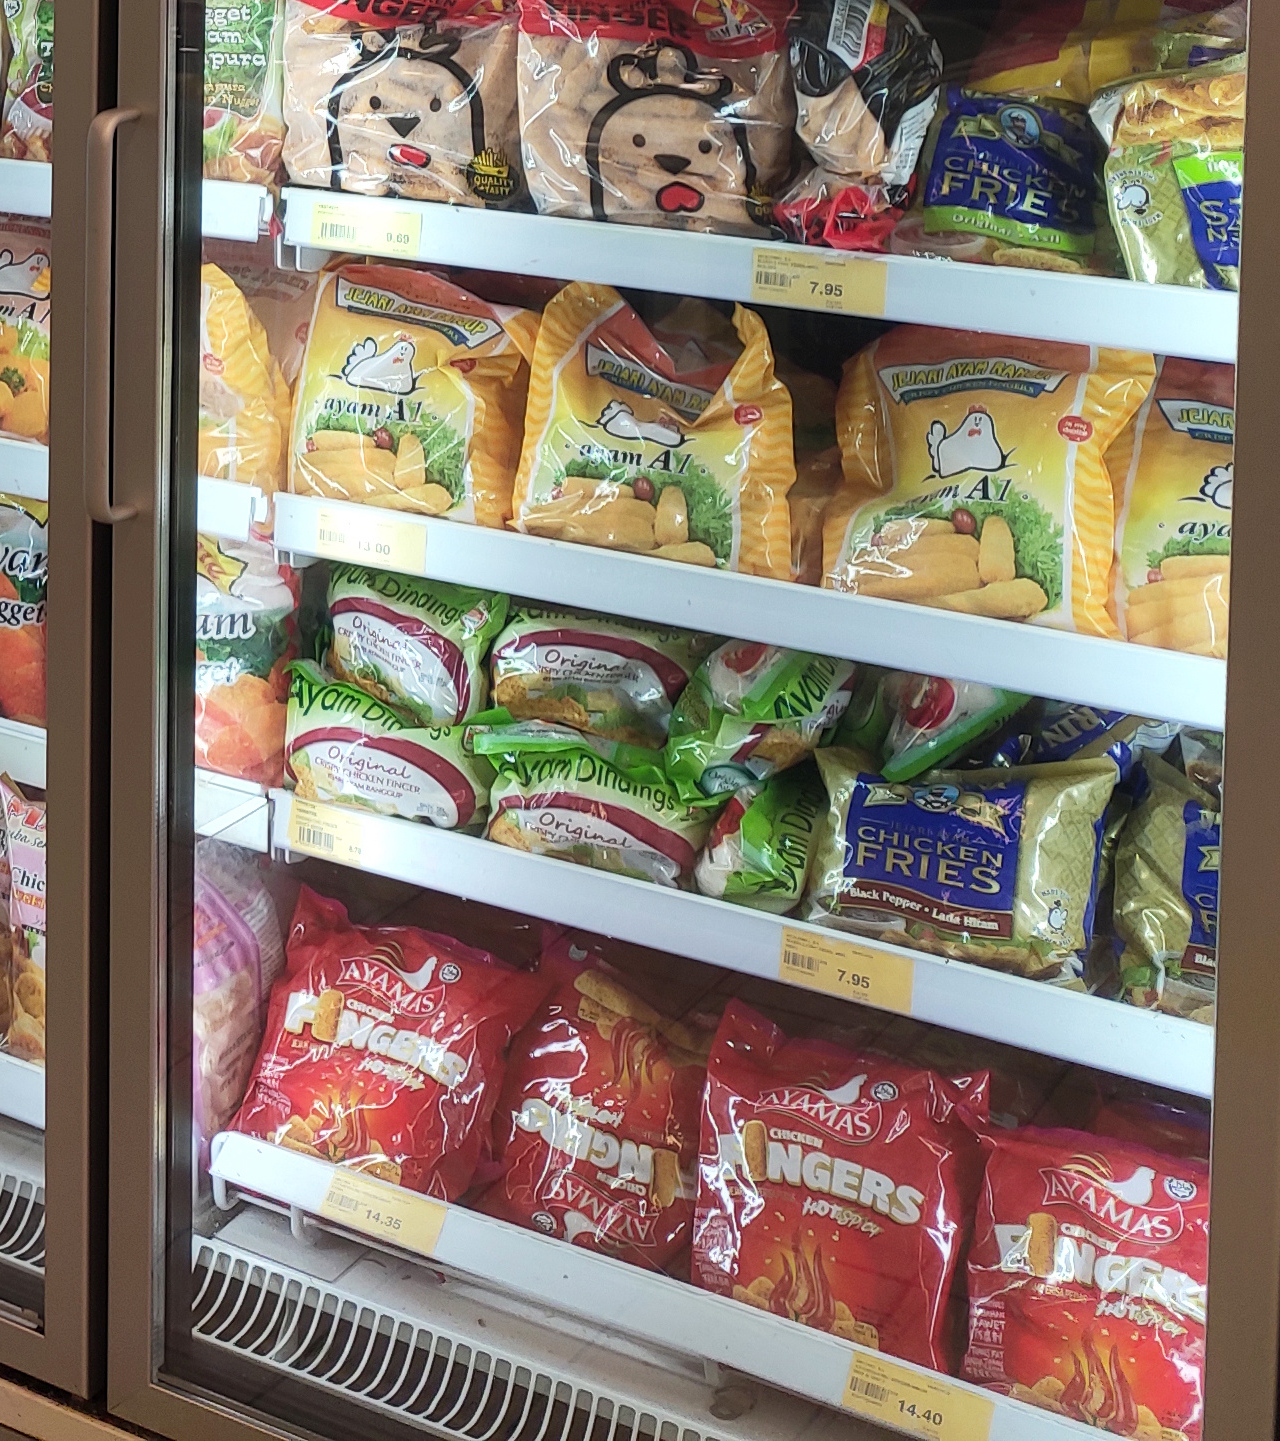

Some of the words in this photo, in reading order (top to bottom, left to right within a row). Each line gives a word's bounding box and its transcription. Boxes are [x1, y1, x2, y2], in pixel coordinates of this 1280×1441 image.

[473, 174, 515, 188] QUALITY
[943, 155, 1087, 200] CHICKEN
[939, 171, 1083, 224] FRIES
[343, 286, 396, 313] JEJARI
[808, 280, 845, 299] 7.95
[945, 360, 989, 382] AYAM
[323, 397, 382, 419] ayam
[648, 379, 687, 406] AYAM
[646, 449, 694, 476] A1
[964, 473, 1013, 504] A1
[543, 647, 631, 673] Original
[290, 674, 363, 718] Ayam
[326, 744, 414, 779] Original
[343, 766, 385, 788] CHICKEN
[386, 779, 422, 796] FINGER
[538, 811, 635, 851] Original
[857, 825, 1003, 869] CHICKEN
[855, 841, 1002, 895] FRIES
[850, 886, 881, 902] Black
[881, 892, 923, 913] Pepper
[931, 907, 960, 926] Lada
[344, 960, 436, 1014] AYAMAS
[836, 967, 871, 991] 7.95
[283, 988, 468, 1090] FINGERS
[763, 1089, 873, 1137] AYAMAS
[769, 1127, 824, 1149] CHICKEN
[719, 1119, 926, 1226] FINGERS
[364, 1207, 404, 1232] 14.35
[1050, 1175, 1174, 1238] AYAMAS
[896, 1399, 944, 1426] 14.40
